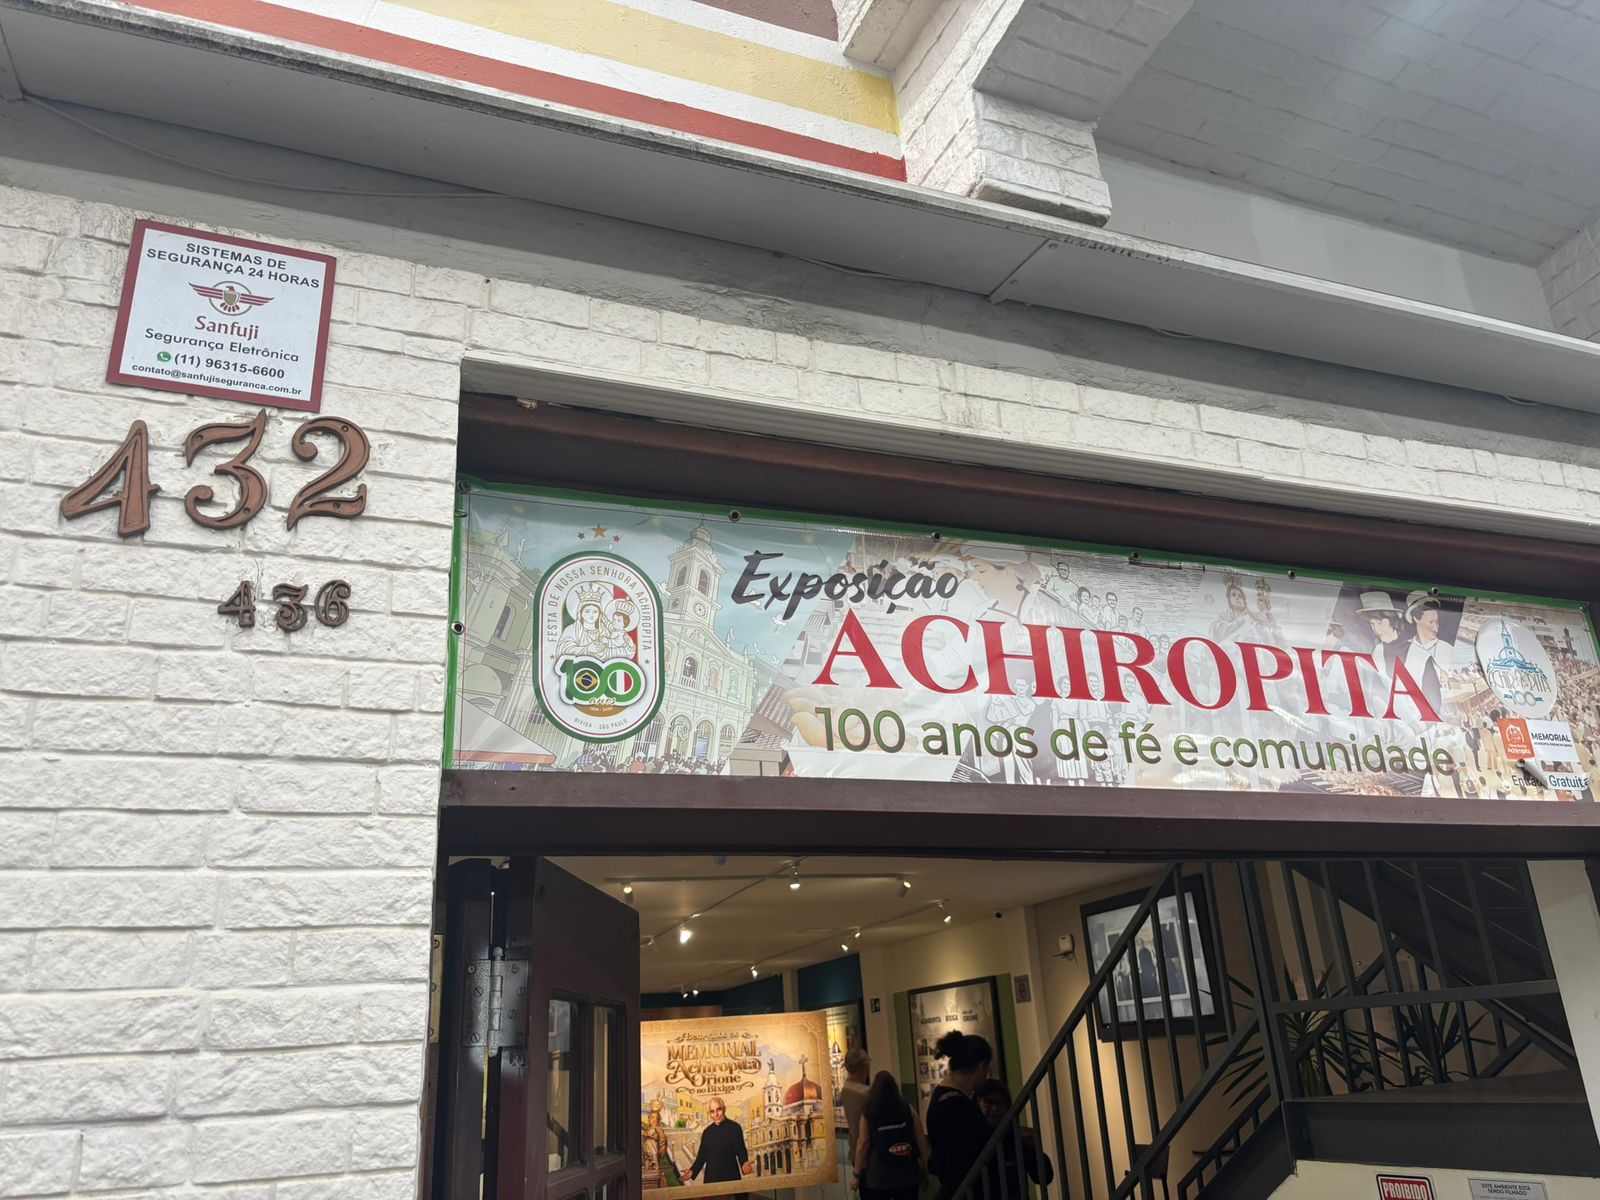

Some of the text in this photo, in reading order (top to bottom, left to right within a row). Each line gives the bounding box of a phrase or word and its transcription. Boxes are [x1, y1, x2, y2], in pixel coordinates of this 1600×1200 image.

[146, 248, 320, 288] SEGURANÇA 24 HORAS
[186, 243, 287, 270] SISTEMAS DE
[145, 327, 299, 362] Segurança Eletrônica
[195, 315, 260, 341] Sanfuji
[132, 363, 302, 395] contato@sanfujiseguranca.com.br
[175, 352, 285, 379] (11) 96315-6600
[60, 408, 370, 538] 432
[731, 550, 959, 620] Exposição
[217, 580, 352, 632] 436
[547, 565, 653, 650] FESTA DE NOSSA SENHORA ACHIROPITA
[559, 658, 642, 702] 100
[811, 608, 1443, 723] ACHIROPITA
[814, 706, 1454, 776] 100 anos de fé e comunidade
[1531, 733, 1571, 742] MEMORIAL
[668, 1040, 761, 1061] MEMORIAL
[1382, 1181, 1428, 1200] PROIBIDO
